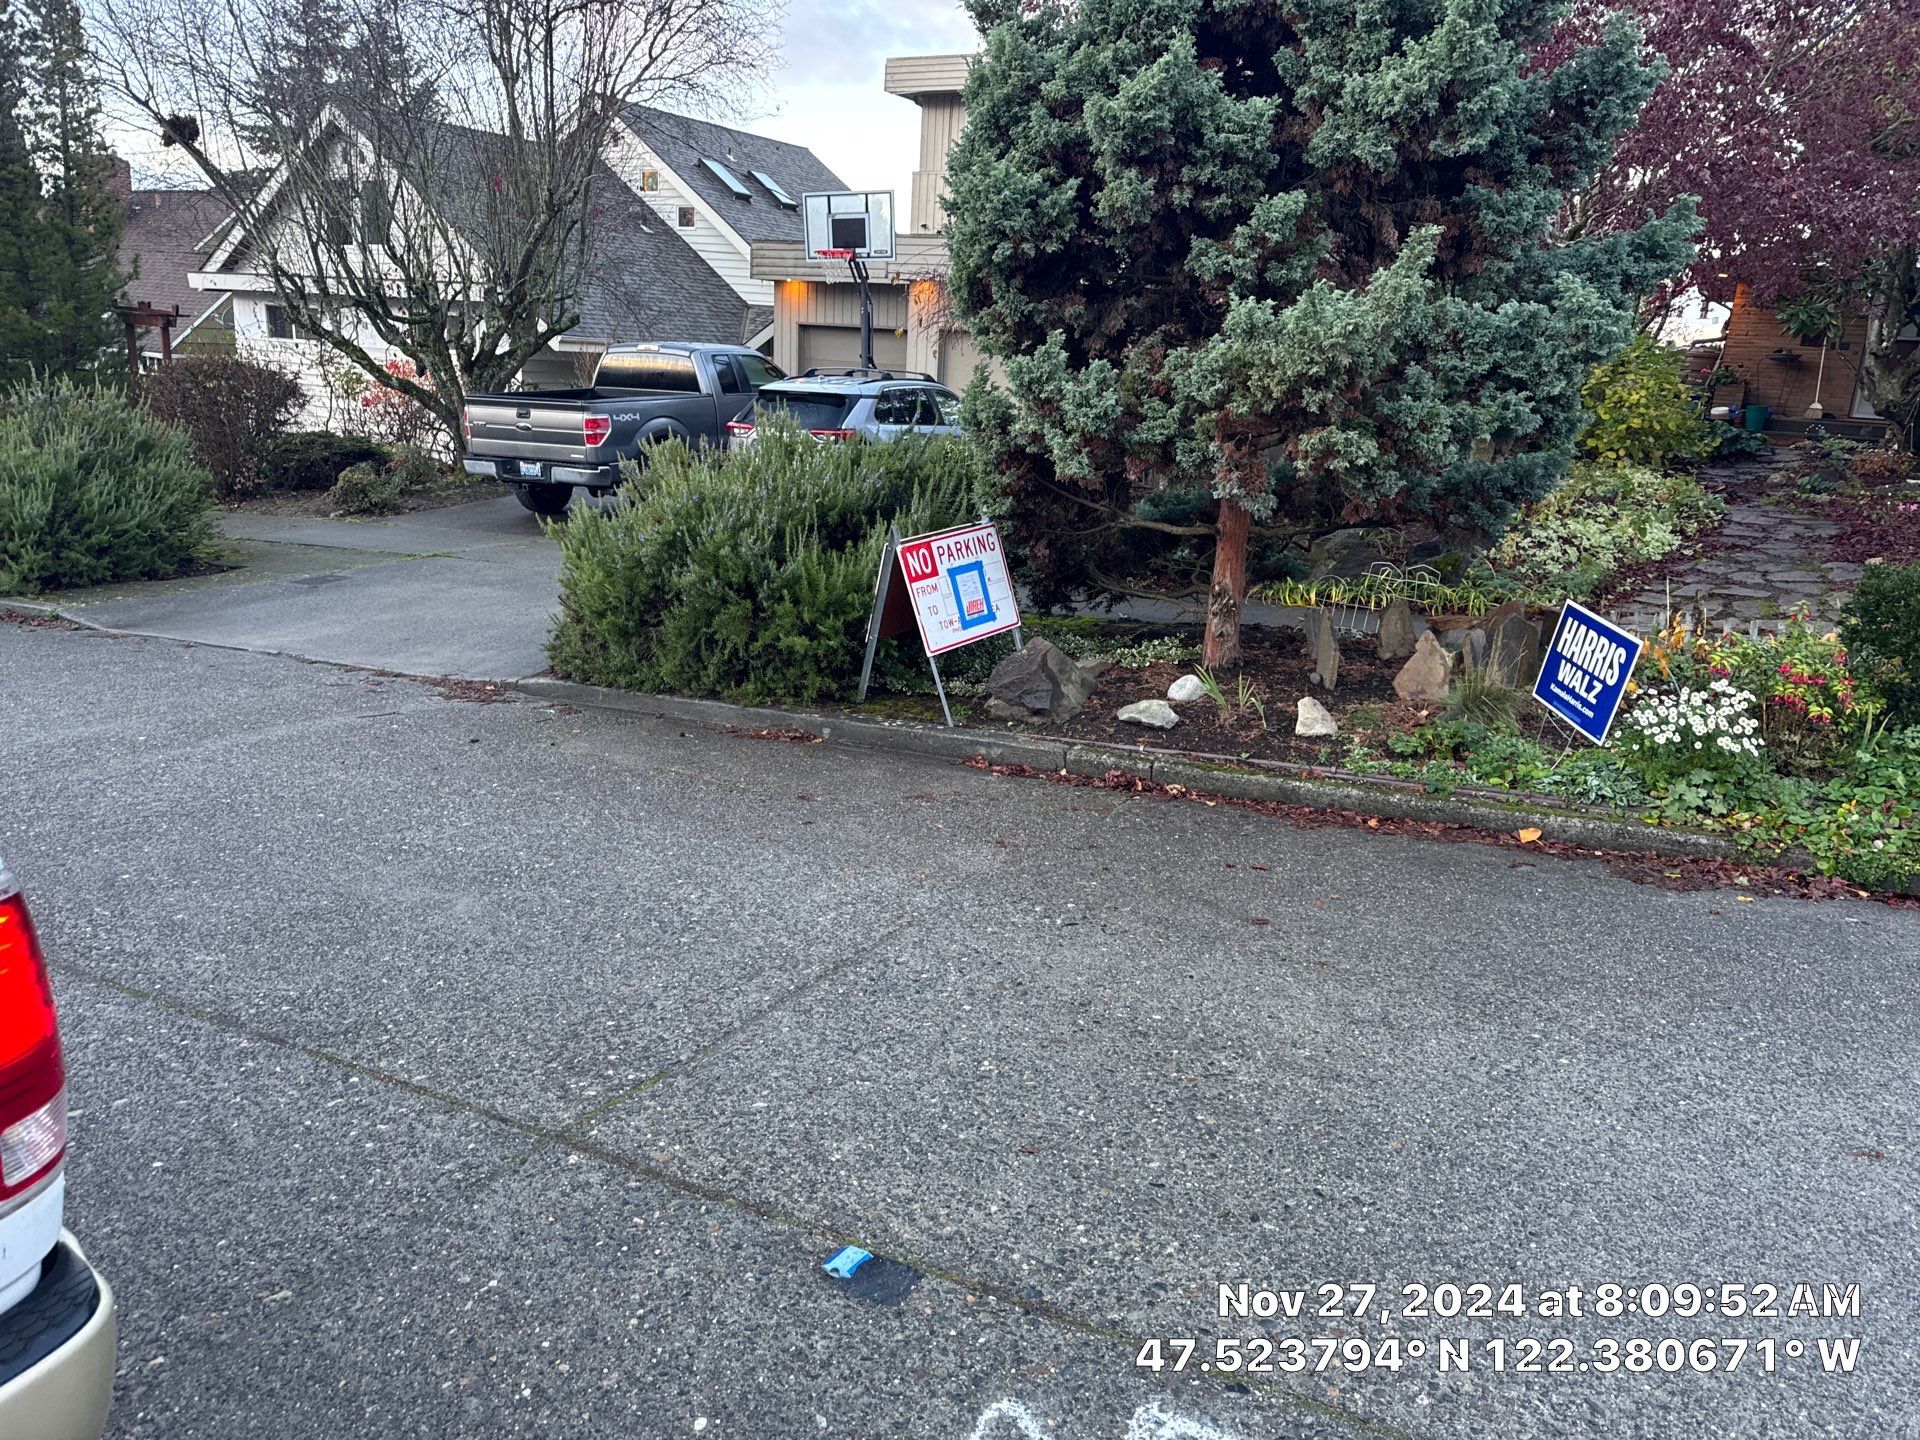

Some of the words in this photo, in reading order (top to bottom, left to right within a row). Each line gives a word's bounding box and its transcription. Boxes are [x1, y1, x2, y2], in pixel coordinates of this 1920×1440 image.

[905, 547, 933, 578] NO
[937, 532, 997, 565] PARKING
[916, 583, 939, 598] FROM
[928, 605, 939, 617] TO
[1556, 616, 1627, 686] HARRIS
[1557, 658, 1604, 705] WALZ
